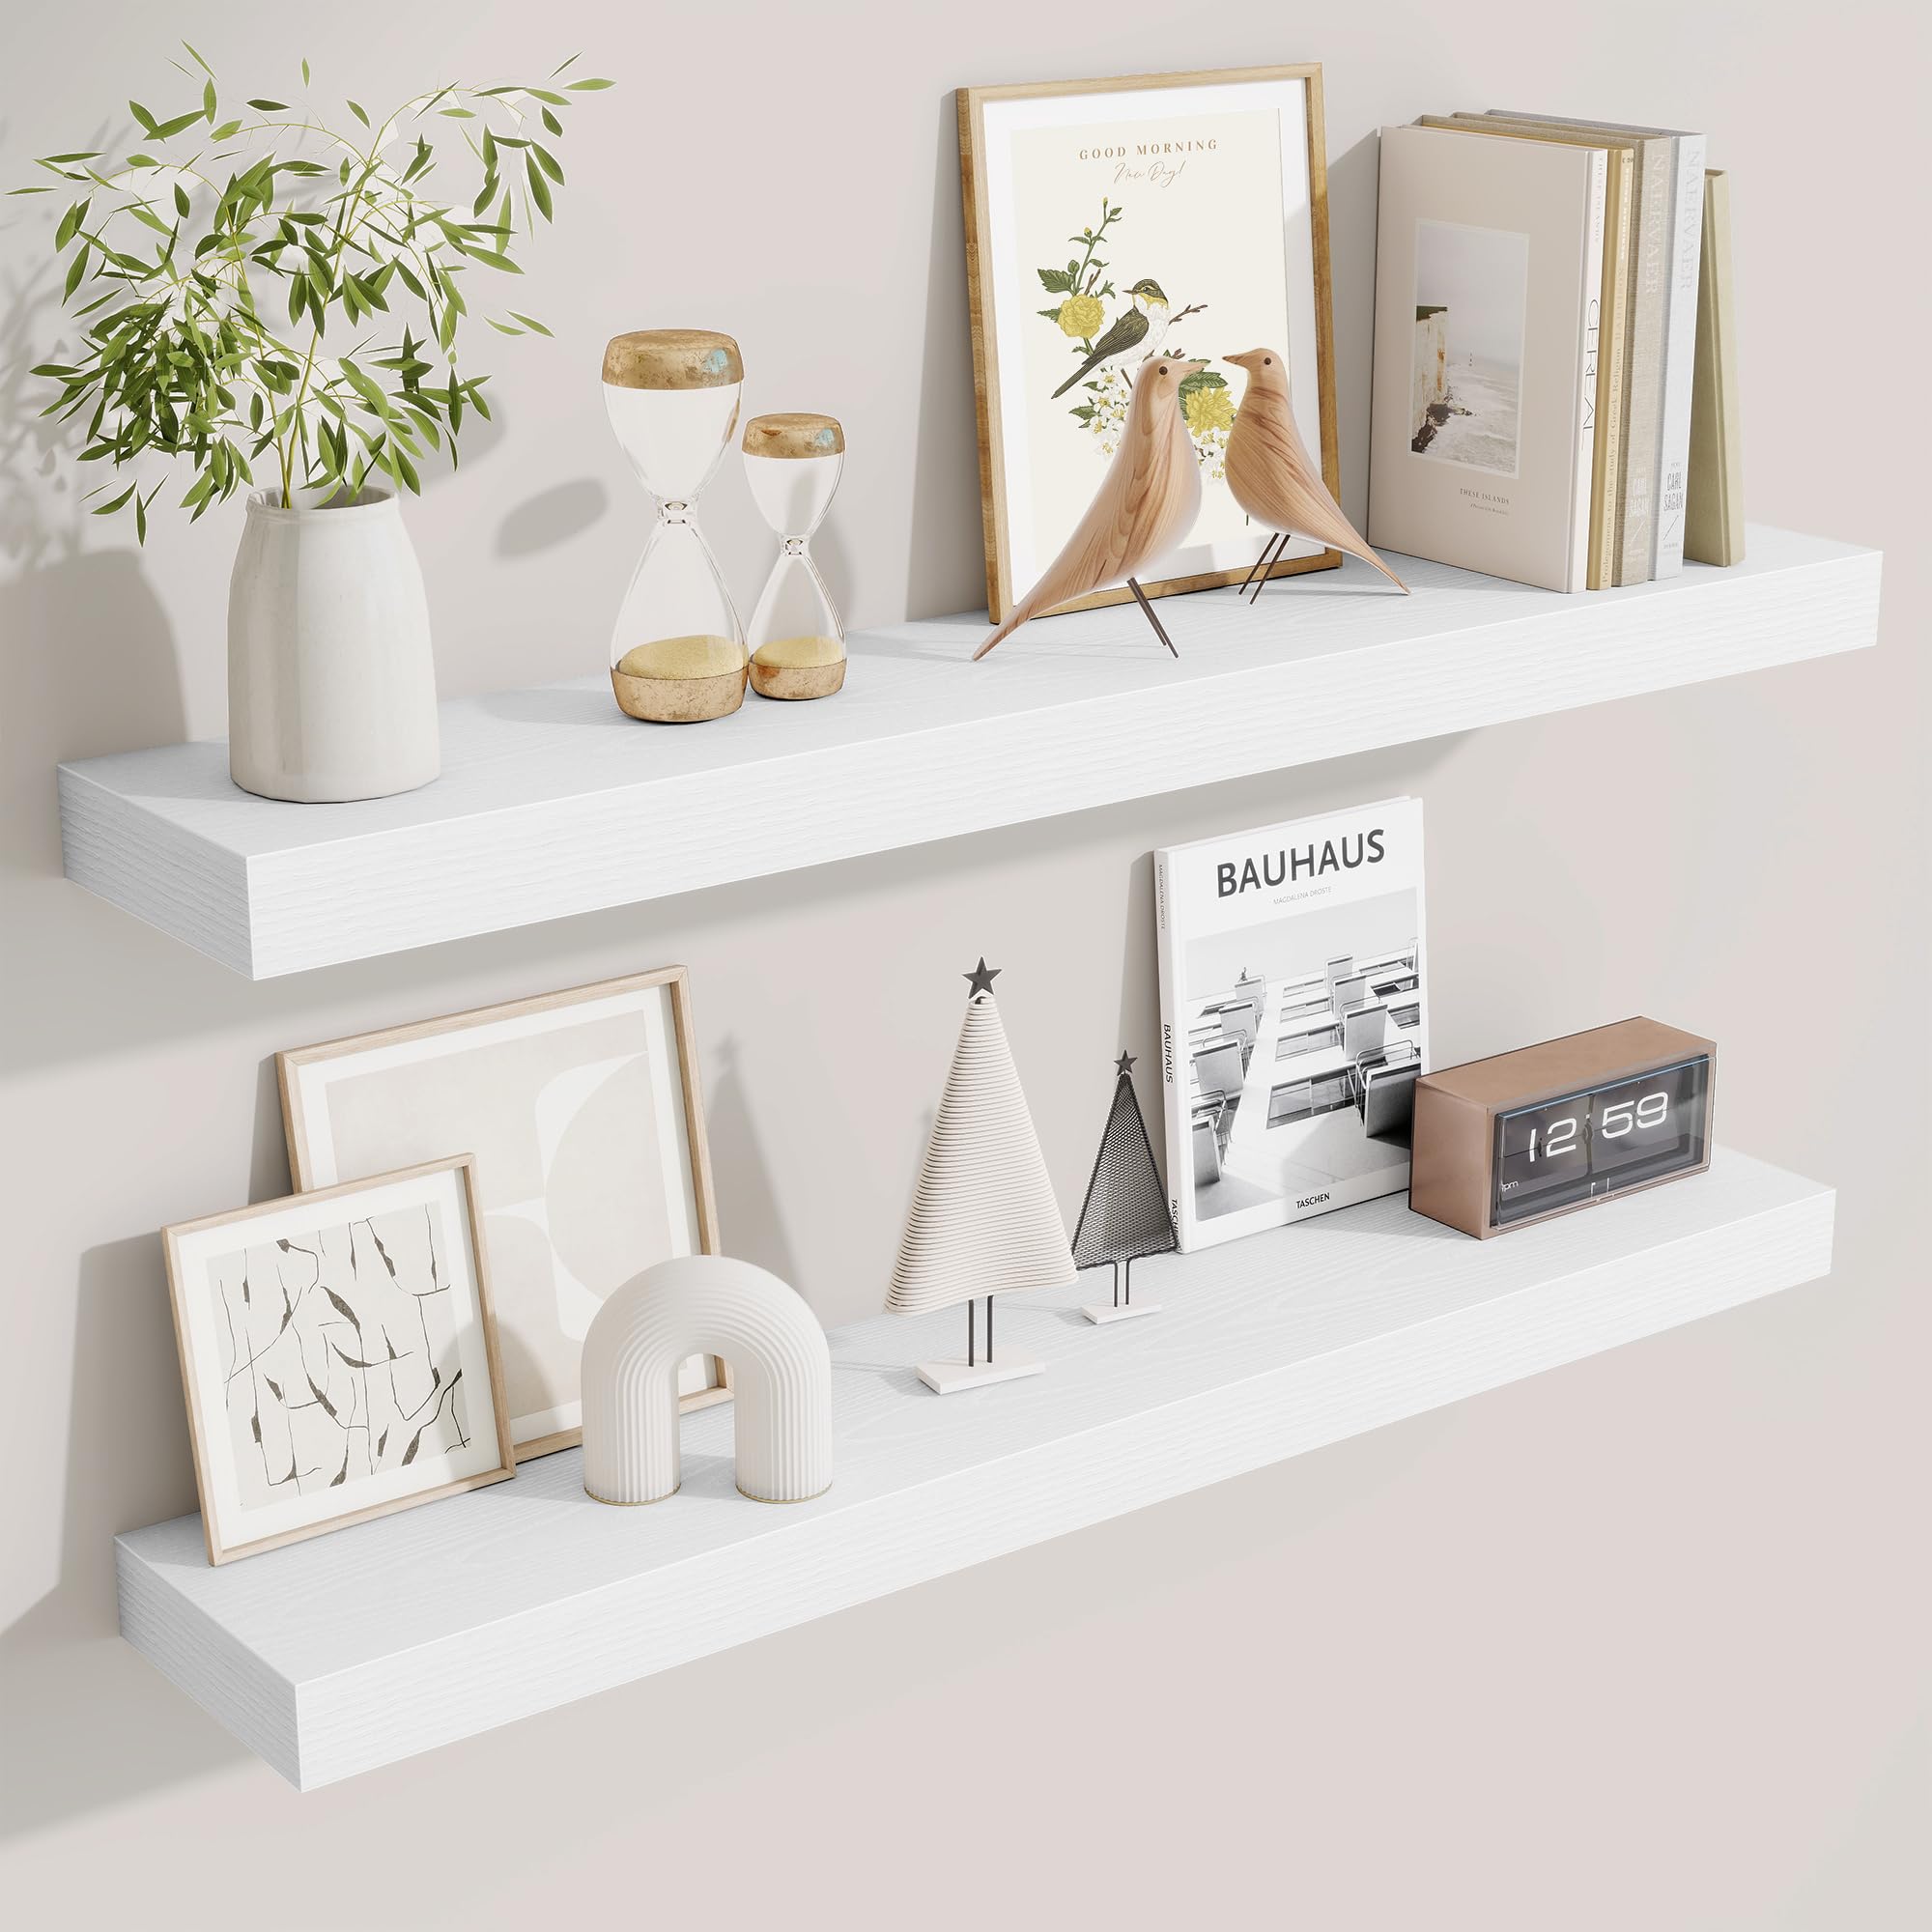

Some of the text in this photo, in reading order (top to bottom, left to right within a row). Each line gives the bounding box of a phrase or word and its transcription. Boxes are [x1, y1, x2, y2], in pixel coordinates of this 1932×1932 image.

[1079, 139, 1217, 160] GOOD MORNING
[1581, 298, 1600, 451] CEREAL
[1612, 348, 1622, 391] Religion
[1666, 471, 1682, 492] CARL
[1460, 488, 1510, 505] THESE ISLANDS
[1663, 492, 1684, 512] SAGAN
[1217, 829, 1384, 898] BAUHAUS
[1273, 886, 1332, 905] MAGDALENA DROSTE
[1163, 1024, 1174, 1084] BAUHAUS
[1295, 1192, 1330, 1208] TASCHEN
